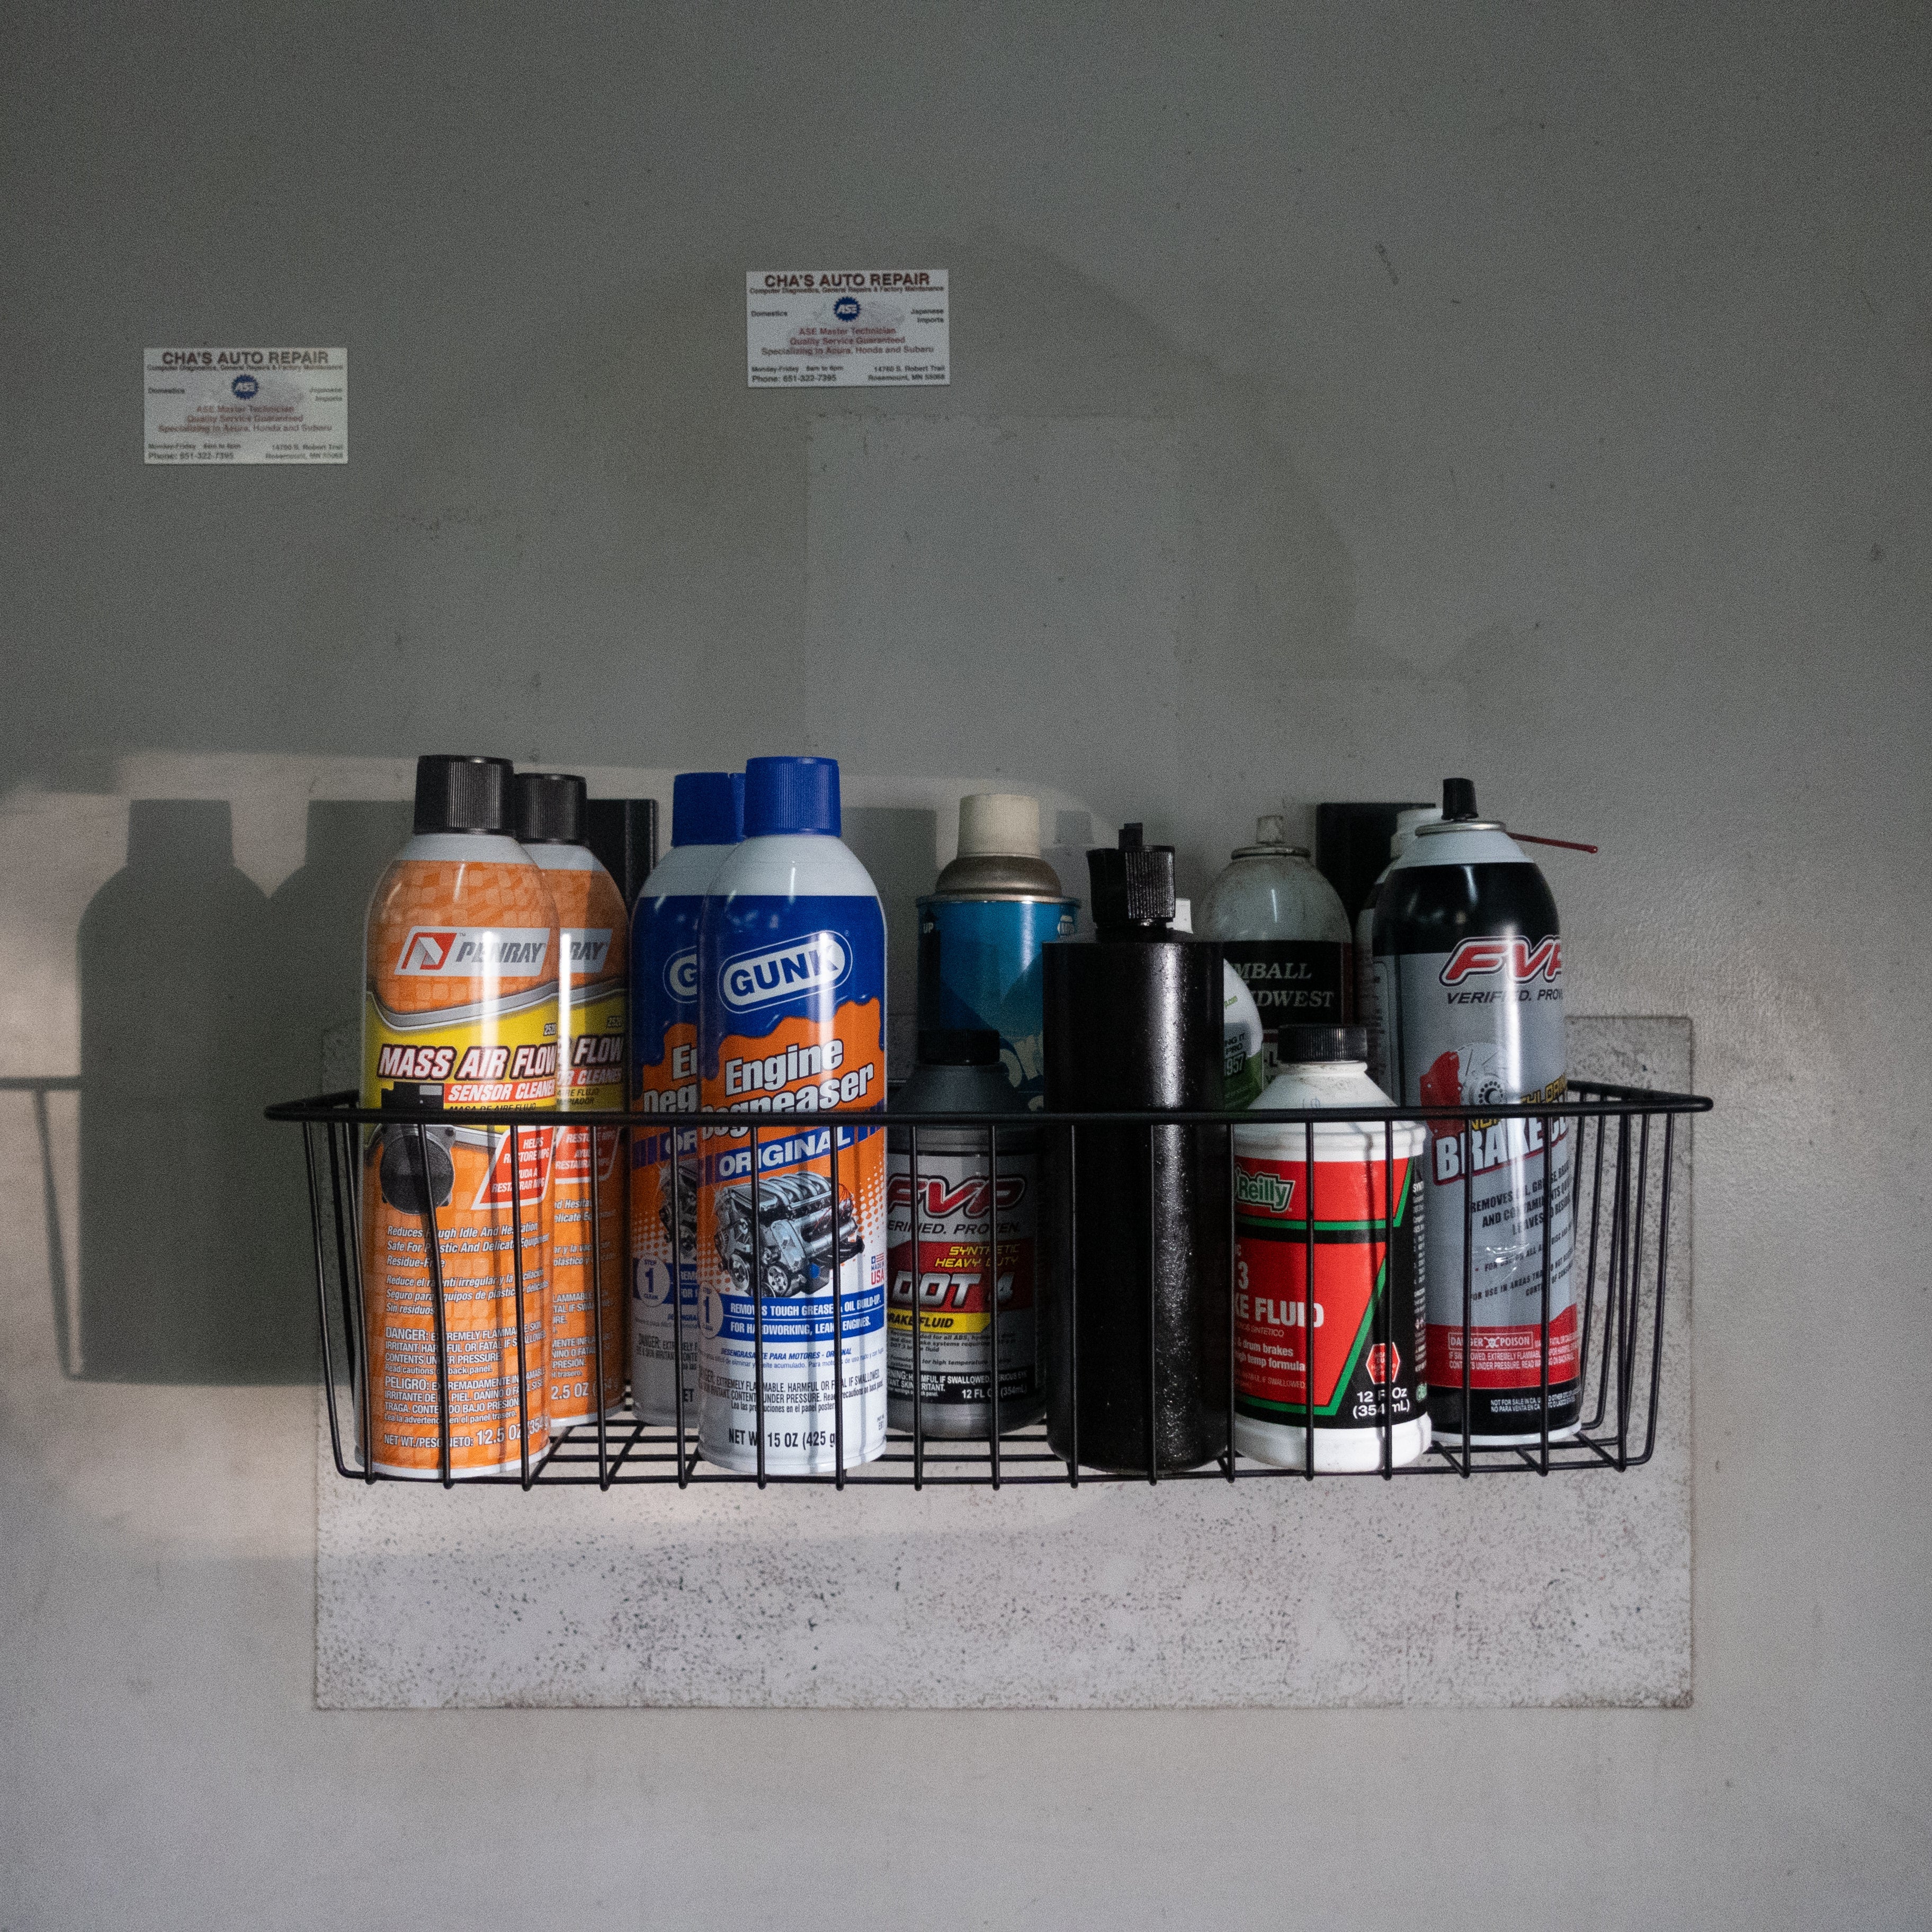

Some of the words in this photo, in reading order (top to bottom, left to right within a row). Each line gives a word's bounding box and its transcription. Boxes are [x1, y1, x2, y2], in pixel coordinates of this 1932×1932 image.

[764, 274, 814, 288] CHA'S
[820, 274, 865, 287] AUTO
[870, 273, 930, 286] REPAIR
[837, 304, 857, 314] ASE
[790, 337, 820, 346] Quality
[162, 352, 212, 364] CHA'S
[218, 352, 263, 364] AUTO
[269, 351, 329, 364] REPAIR
[762, 347, 813, 356] Specializing
[923, 922, 934, 934] UP
[730, 944, 839, 997] GUNK
[1232, 962, 1312, 980] MBALL
[1447, 989, 1532, 1005] VERIFD.
[379, 1045, 454, 1079] MASS
[458, 1045, 509, 1078] AIR
[511, 1044, 557, 1078] FLOW
[726, 1039, 844, 1096] Engine
[448, 1083, 512, 1102] SENSOR
[515, 1079, 556, 1100] CLEANER
[719, 1126, 851, 1177] ORGINAL
[1472, 1192, 1513, 1213] REMOVES
[1483, 1212, 1501, 1228] AND
[387, 1226, 423, 1238] Reduces
[459, 1227, 477, 1238] Idle
[480, 1226, 499, 1237] And
[953, 1222, 1020, 1235] PROEN.
[387, 1240, 405, 1252] Safe
[407, 1241, 422, 1253] For
[460, 1242, 479, 1253] And
[949, 1244, 1021, 1256] SYNTETIC
[935, 1258, 981, 1268] HEAVY
[387, 1275, 414, 1286] Reduce
[416, 1276, 424, 1287] el
[458, 1276, 497, 1288] irregular
[506, 1275, 513, 1284] la
[645, 1268, 654, 1292] 1
[871, 1271, 884, 1285] USA
[387, 1289, 413, 1302] Seguro
[415, 1291, 434, 1302] para
[475, 1290, 486, 1300] de
[892, 1272, 981, 1307] DOT
[1485, 1287, 1498, 1298] USE
[387, 1302, 397, 1313] Sin
[399, 1304, 435, 1315] residuos
[730, 1302, 767, 1316] REMOVS
[770, 1304, 800, 1317] TOUGH
[801, 1303, 834, 1316] GREASE
[844, 1300, 855, 1312] OIL
[1255, 1297, 1324, 1328] FLUID
[730, 1321, 745, 1334] FOR
[746, 1322, 813, 1336] HADWORKING,
[843, 1316, 871, 1331] ENGINES.
[920, 1317, 954, 1328] FLUID
[385, 1326, 429, 1341] DANGER:
[385, 1340, 420, 1353] IRRITANT.
[464, 1343, 476, 1353] OR
[479, 1340, 503, 1352] FATAL
[504, 1338, 511, 1348] IF
[1243, 1340, 1260, 1352] drum
[1263, 1343, 1294, 1357] brakes
[1451, 1337, 1483, 1347] DAGER
[1500, 1336, 1529, 1347] POISON
[385, 1353, 424, 1365] CONTENTS
[457, 1352, 503, 1365] PRESSURE.
[769, 1349, 786, 1361] PARA
[789, 1349, 820, 1360] MOTORES
[1488, 1352, 1516, 1361] EXTREMELY
[1247, 1354, 1267, 1367] temp
[1268, 1357, 1306, 1371] formula
[1476, 1361, 1493, 1370] UNDER
[1495, 1361, 1520, 1370] PRESSURE.
[402, 1365, 434, 1375] cautions
[449, 1365, 467, 1375] back
[469, 1364, 493, 1376] panel.
[384, 1376, 430, 1391] PELIGRO:
[940, 1375, 946, 1383] IF
[574, 1383, 589, 1397] OZ
[788, 1382, 819, 1392] HARMFUL
[821, 1381, 830, 1391] OR
[384, 1390, 423, 1402] IRRITANTE
[425, 1393, 436, 1403] DE
[451, 1392, 472, 1403] PIEL.
[474, 1388, 503, 1401] DAÑINO
[763, 1392, 784, 1403] UNDER
[786, 1392, 822, 1403] PRESSURE.
[962, 1389, 972, 1399] 12
[974, 1389, 985, 1398] FL
[1357, 1391, 1373, 1403] 12
[1392, 1387, 1407, 1399] Oz
[384, 1401, 410, 1414] TRAGA.
[462, 1403, 485, 1413] BAJO
[795, 1403, 800, 1412] el
[802, 1403, 817, 1414] panel
[1353, 1403, 1384, 1419] (354
[384, 1413, 396, 1421] Lea
[397, 1413, 403, 1423] la
[470, 1414, 490, 1424] panel
[492, 1410, 517, 1420] trasero.
[384, 1434, 399, 1445] NET
[477, 1427, 505, 1446] 12.5
[729, 1428, 745, 1446] NET
[768, 1433, 781, 1447] 15
[784, 1433, 798, 1447] OZ
[802, 1431, 826, 1450] (425
